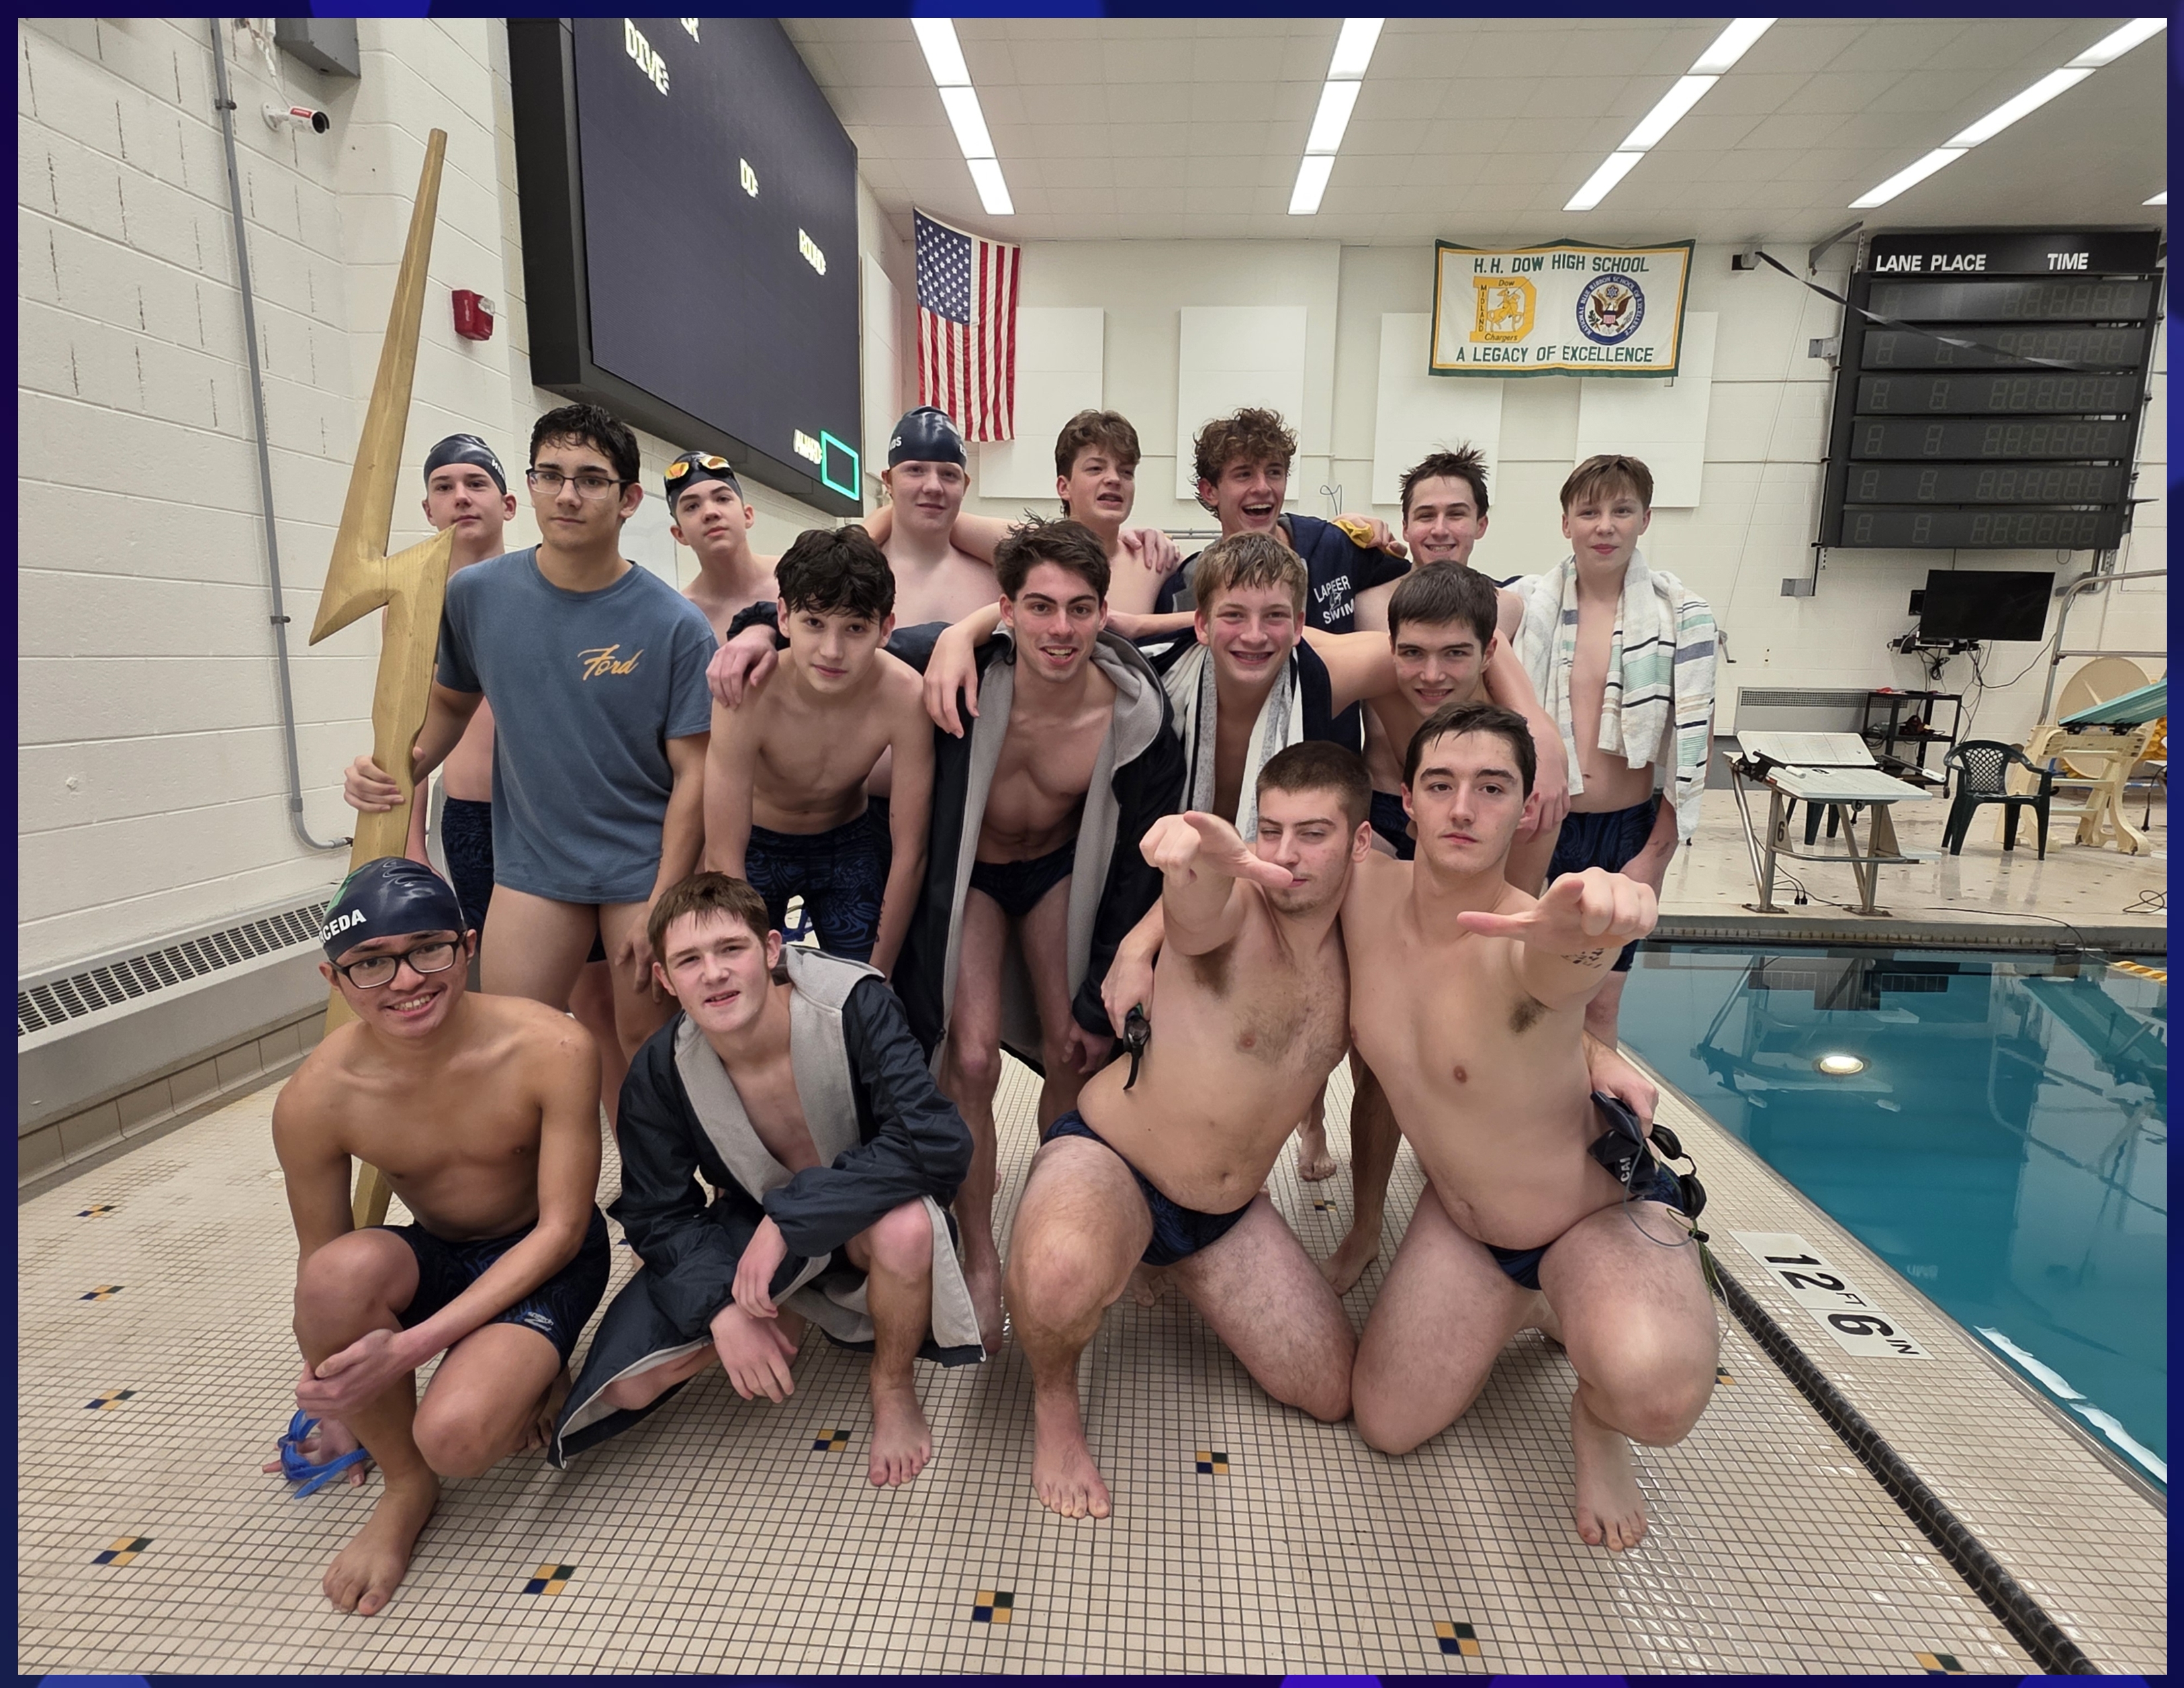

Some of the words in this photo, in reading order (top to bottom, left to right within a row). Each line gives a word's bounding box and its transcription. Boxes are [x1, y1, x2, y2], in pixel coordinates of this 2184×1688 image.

[1512, 256, 1544, 273] DOW
[1552, 254, 1586, 270] HIGH
[1592, 256, 1649, 273] SCHOOL
[1876, 255, 1922, 271] LANE
[1931, 254, 1986, 271] PLACE
[2047, 253, 2089, 270] TIME
[1613, 276, 1635, 290] SCHOOL
[1479, 285, 1487, 332] MIDLAND
[1484, 333, 1518, 342] Chargers
[1456, 347, 1465, 362] A
[1473, 347, 1529, 362] LEGACY
[1536, 346, 1557, 361] OF
[1562, 346, 1654, 362] EXCELLENCE
[1314, 575, 1351, 603] LAPEER
[1323, 598, 1354, 624] SWIM
[577, 644, 644, 680] Ford
[1777, 821, 1785, 842] 6
[1764, 1254, 1845, 1291] 12
[1836, 1293, 1867, 1307] FT
[1827, 1313, 1894, 1336] 6
[1886, 1339, 1920, 1354] IN
